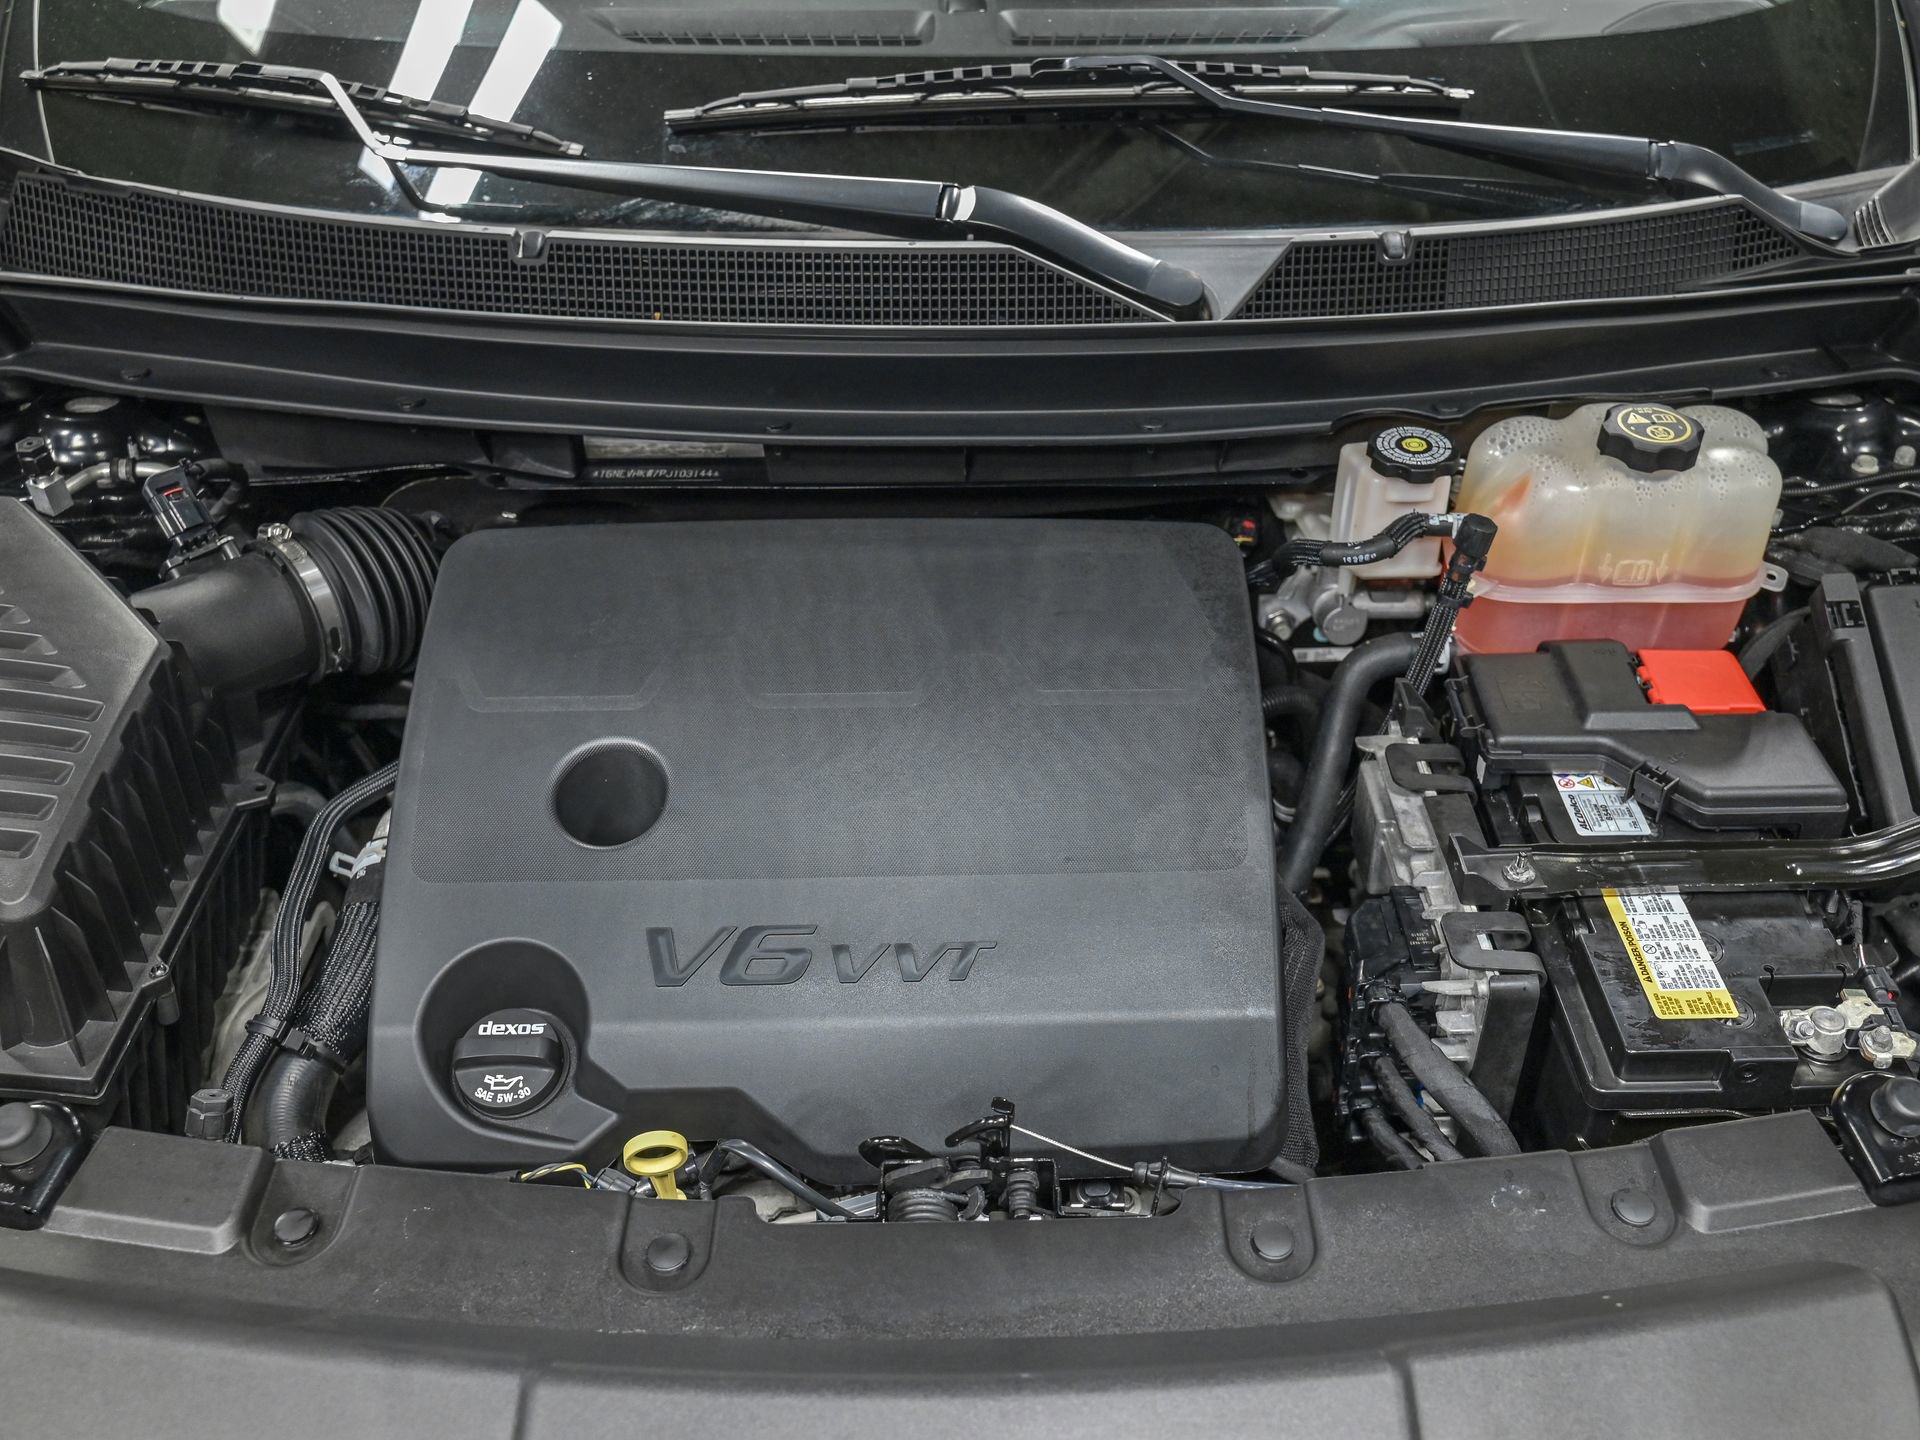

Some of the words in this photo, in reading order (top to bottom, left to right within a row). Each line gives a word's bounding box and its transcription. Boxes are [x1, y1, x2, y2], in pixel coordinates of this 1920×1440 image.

[1568, 794, 1589, 831] ACDelco
[645, 924, 818, 988] V6
[831, 940, 998, 983] VVT
[478, 1020, 548, 1036] dexos
[474, 1087, 495, 1103] SAE
[496, 1086, 532, 1104] 5W-30
